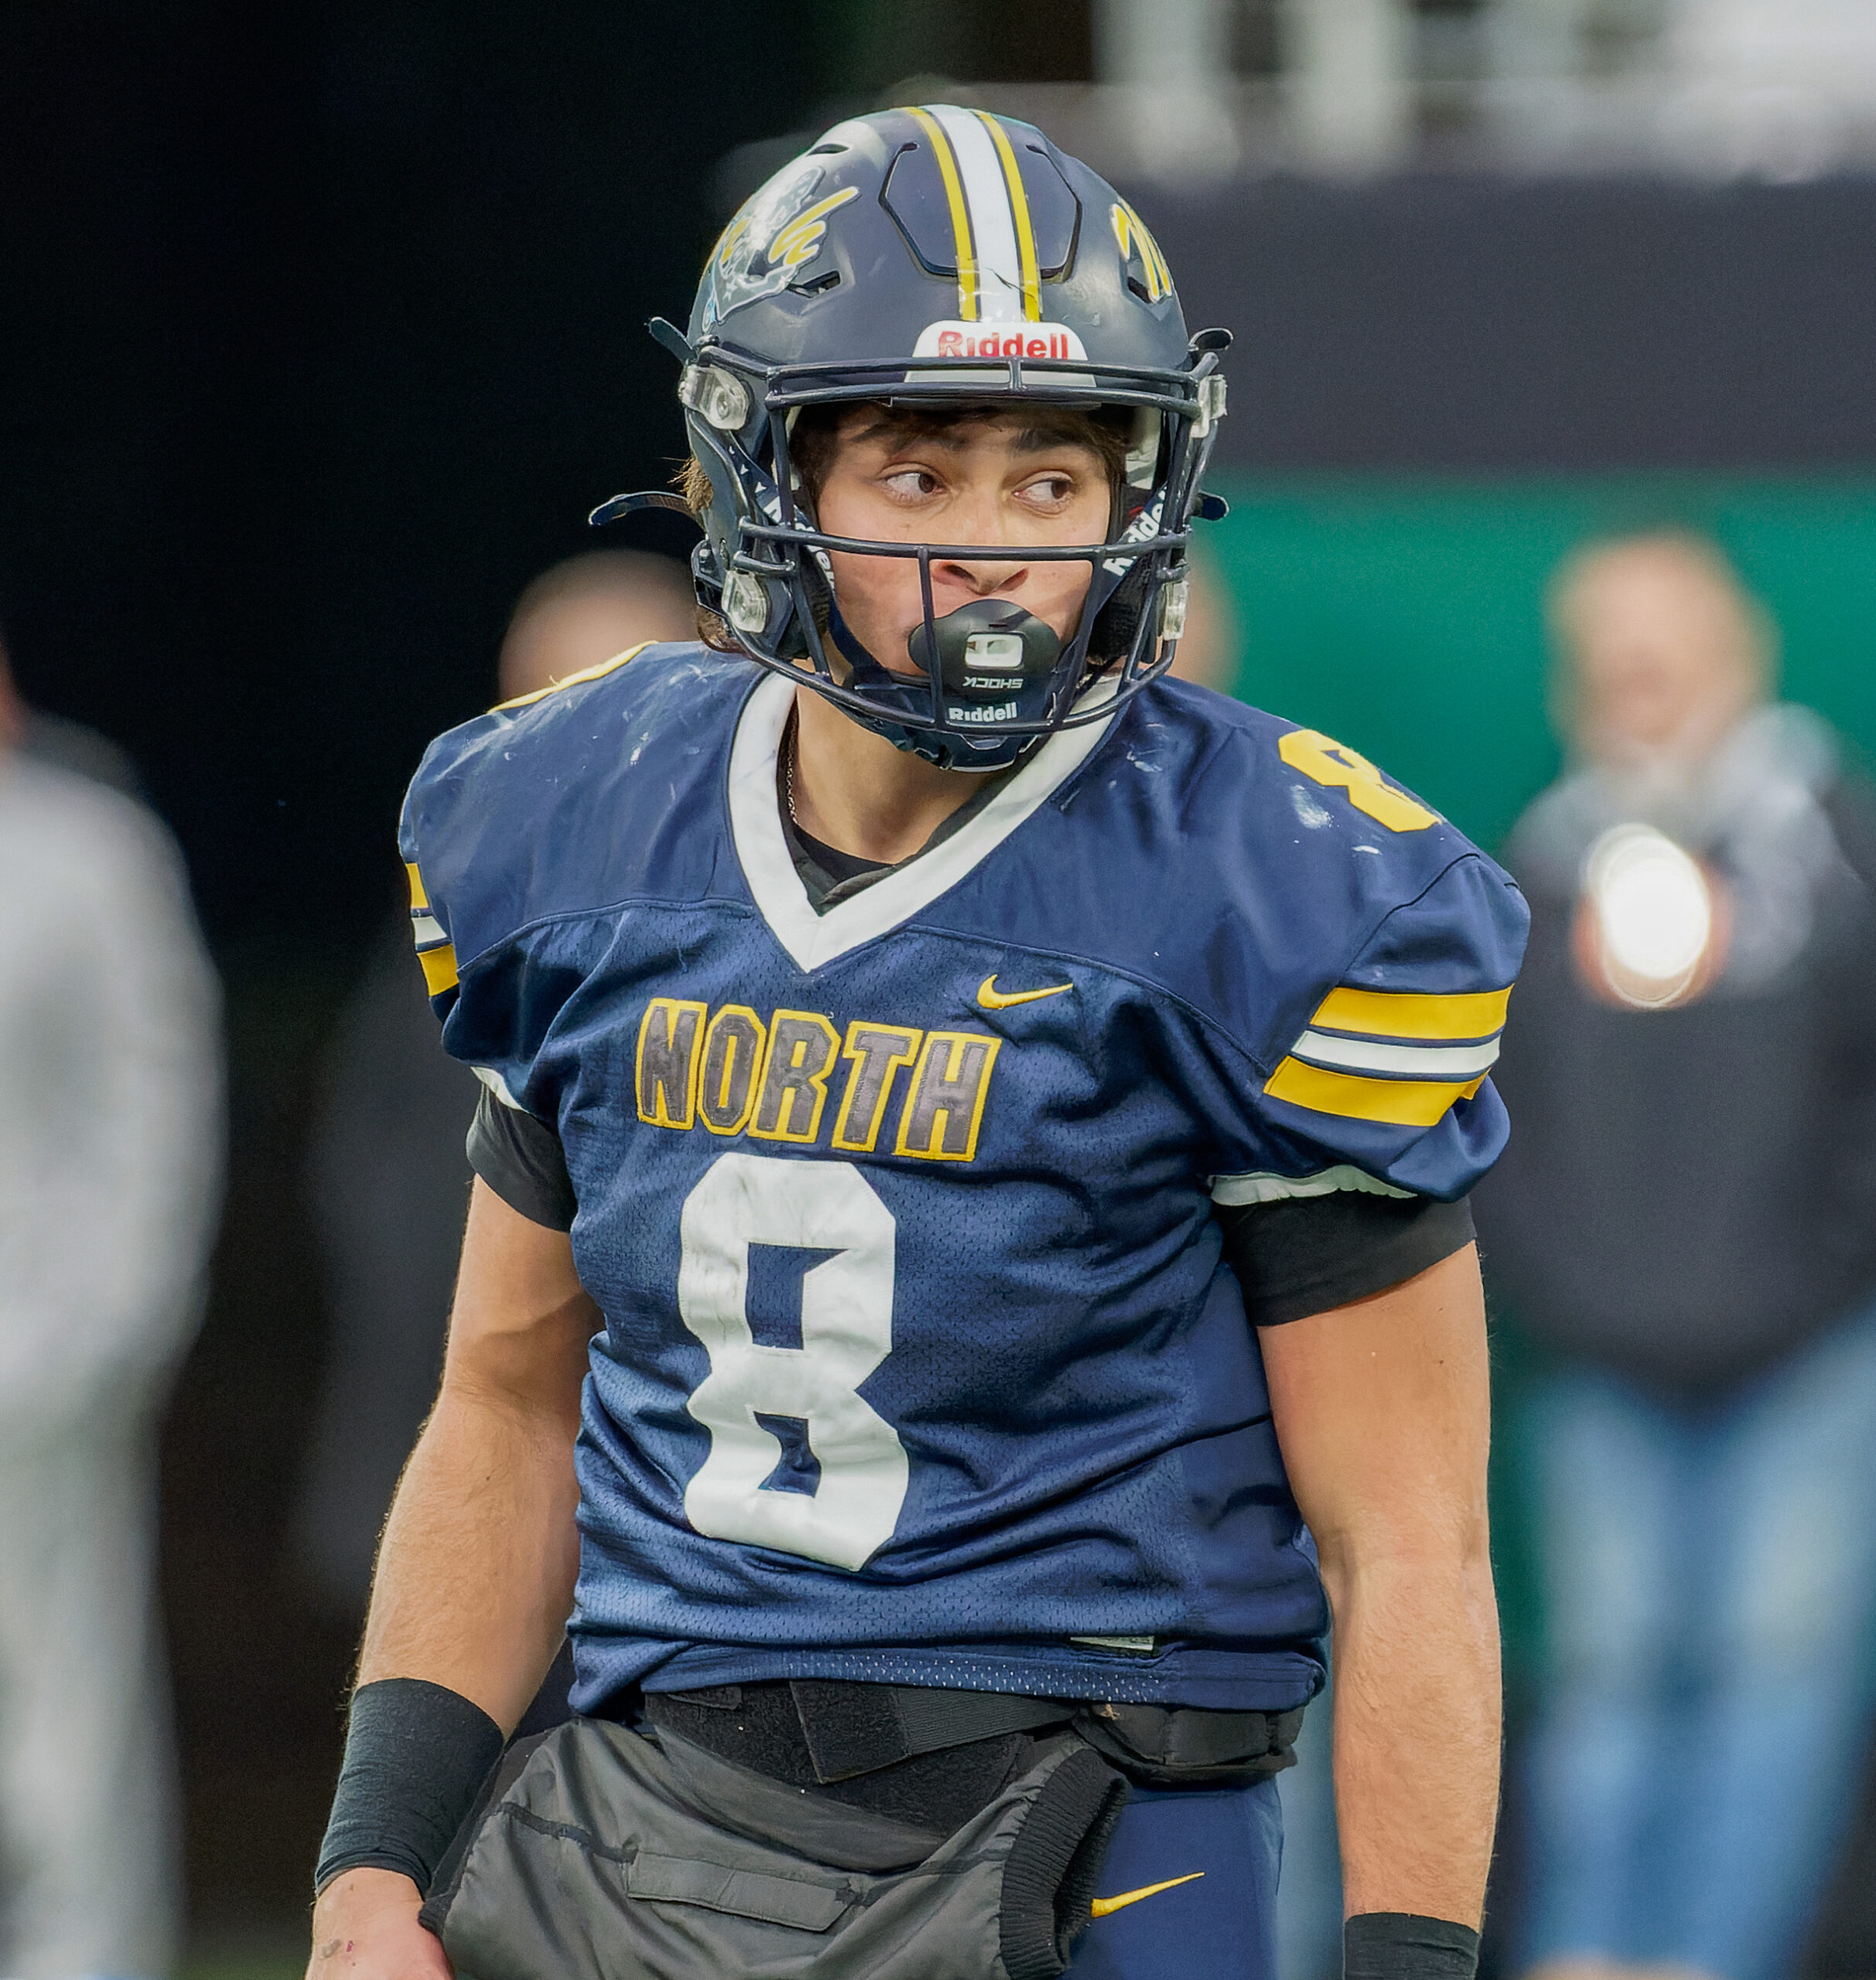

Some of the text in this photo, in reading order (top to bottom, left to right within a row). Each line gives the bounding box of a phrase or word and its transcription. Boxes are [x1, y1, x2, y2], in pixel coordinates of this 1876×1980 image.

[938, 331, 1068, 360] Riddell
[1102, 490, 1167, 577] Rdde
[948, 702, 1017, 722] Riddell
[1278, 729, 1442, 832] 8
[636, 998, 1002, 1162] NORTH
[678, 1152, 910, 1572] 8
